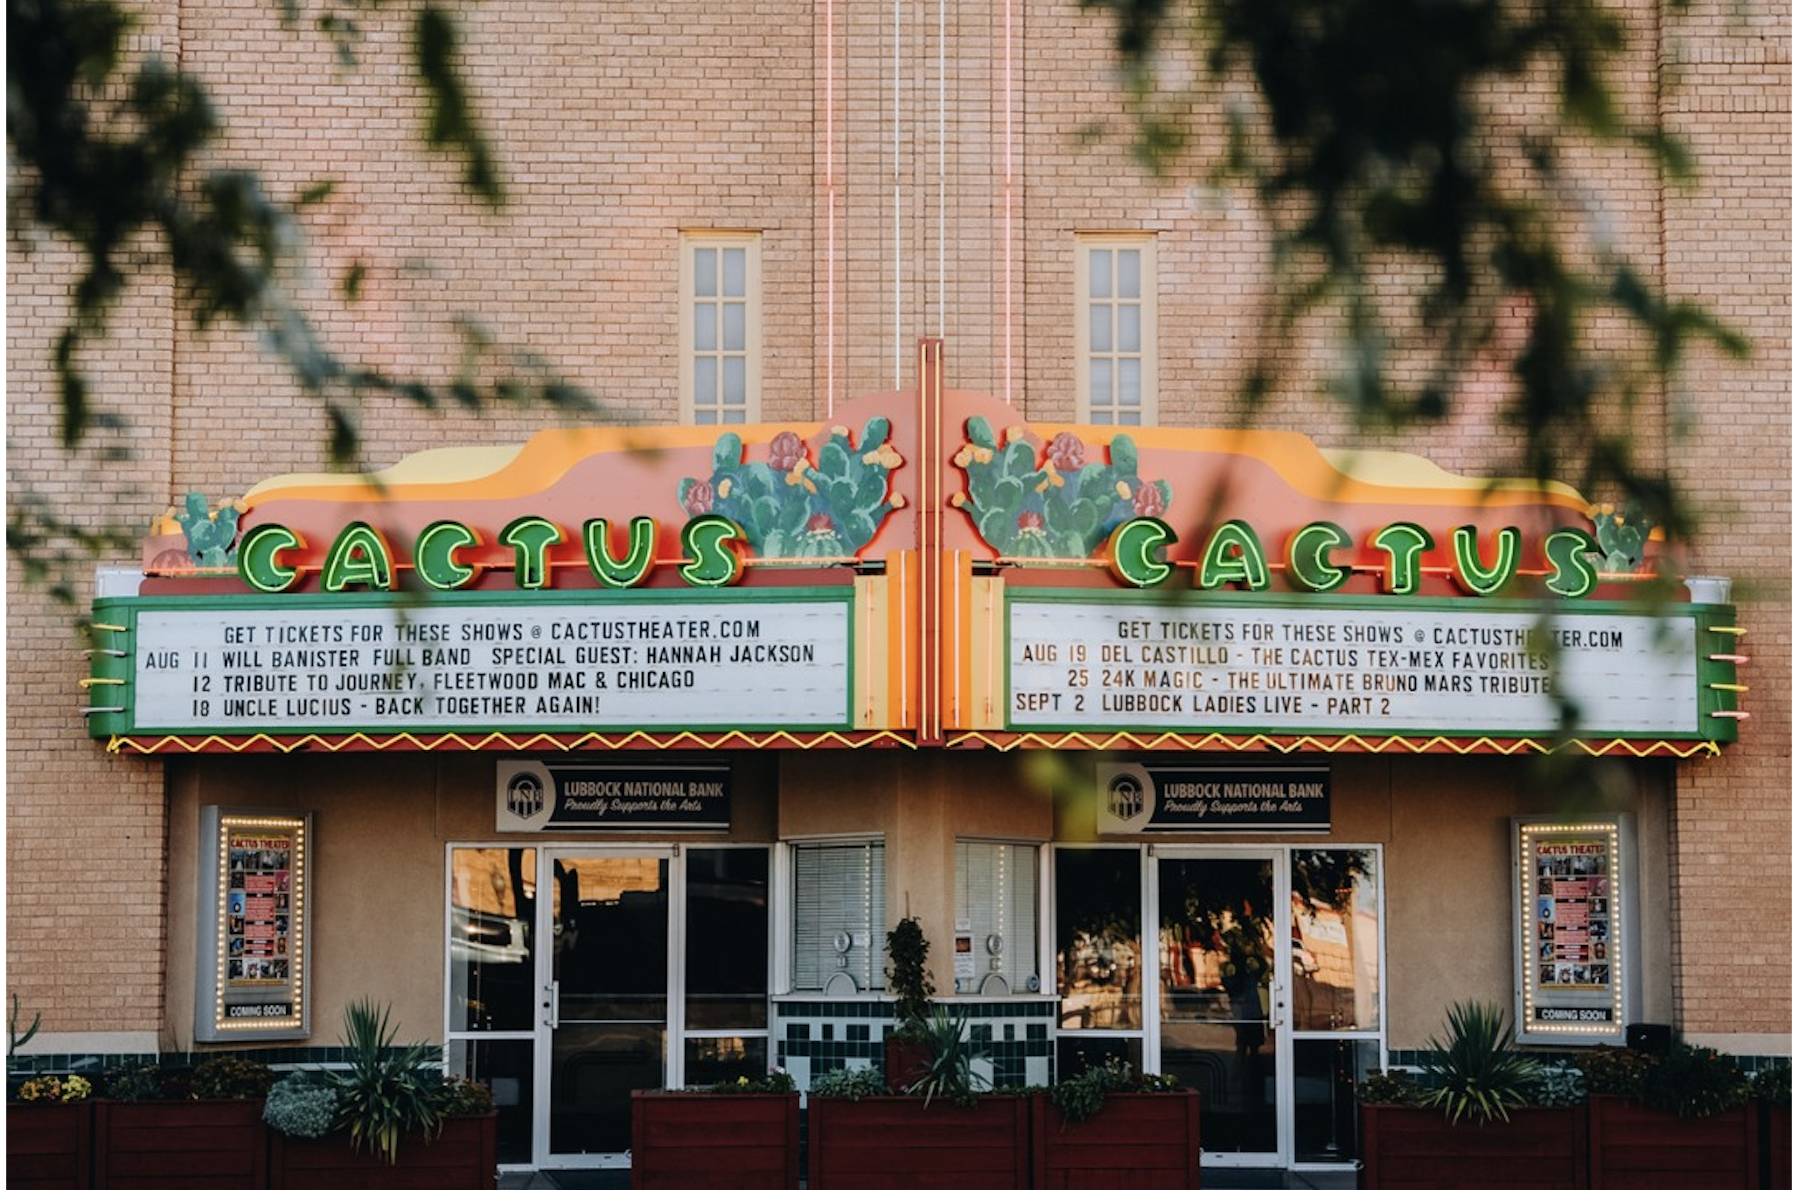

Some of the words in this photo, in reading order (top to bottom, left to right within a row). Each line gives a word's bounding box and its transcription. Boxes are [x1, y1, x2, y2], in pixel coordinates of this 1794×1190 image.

[237, 515, 747, 593] CACTUS
[1105, 516, 1598, 597] CACTUS
[225, 627, 256, 643] GET
[266, 626, 342, 643] TICKETS
[351, 625, 382, 642] FOR
[395, 624, 450, 641] THESE
[462, 623, 522, 640] SHOWS
[551, 621, 759, 639] CACTUSTHEATER.COM
[1118, 621, 1150, 639] GET
[1161, 622, 1234, 640] TICKETS
[1243, 623, 1273, 641] FOR
[1282, 624, 1336, 642] THESE
[1343, 626, 1403, 643] SHOWS
[1434, 628, 1622, 648] CACTUSTHTER.COM
[146, 652, 179, 669] AUG
[193, 652, 208, 668] 11
[222, 651, 262, 668] WILL
[272, 650, 359, 667] BANISTER
[373, 649, 415, 666] FULL
[423, 648, 470, 666] BAND
[492, 647, 565, 665] SPECIAL
[576, 646, 638, 664] GUEST:
[647, 645, 721, 663] HANNAH
[730, 645, 814, 662] JACKSON
[1023, 645, 1057, 661] AUG
[1070, 645, 1086, 661] 19
[1102, 646, 1132, 663] DEL
[1141, 646, 1228, 664] CASTILLO
[1251, 648, 1282, 665] THE
[1291, 649, 1357, 667] CACTUS
[1369, 651, 1444, 668] TEX-MEX
[1453, 652, 1549, 670] FAVORITES
[193, 675, 211, 692] 12
[224, 675, 297, 692] TRIBUTE
[307, 674, 328, 691] TO
[336, 673, 425, 690] JOURNEY,
[434, 672, 538, 690] FLEETWOOD
[548, 672, 586, 689] MAC
[596, 672, 607, 688] &
[617, 670, 694, 688] CHICAGO
[1068, 670, 1088, 687] 25
[1102, 670, 1135, 687] 24K
[1144, 671, 1203, 688] MAGIC
[1227, 672, 1259, 689] THE
[1266, 672, 1354, 690] ULTIMATE
[1364, 674, 1417, 692] BRUNO
[1425, 675, 1472, 692] MARS
[1480, 676, 1550, 693] TRIBUTE
[193, 700, 209, 716] 18
[224, 700, 277, 716] UNCLE
[287, 699, 351, 715] LUCIUS
[376, 698, 423, 715] BACK
[436, 697, 526, 714] TOGETHER
[537, 696, 600, 713] AGAIN!
[1016, 693, 1062, 711] SEPT
[1075, 694, 1085, 711] 2
[1102, 694, 1183, 712] LUBBOCK
[1193, 695, 1256, 713] LADIES
[1264, 696, 1302, 713] LIVE
[1328, 697, 1372, 715] PART
[1381, 698, 1390, 715] 2
[564, 781, 621, 797] LUBBOCK
[624, 781, 687, 797] NATIONAL
[689, 782, 723, 797] BANK
[1164, 783, 1220, 798] LUBBOCK
[1224, 783, 1286, 798] NATIONAL
[1289, 783, 1324, 798] BANK
[564, 799, 608, 816] Proudly
[610, 799, 657, 814] Supports
[660, 799, 676, 811] the
[679, 800, 702, 811] Arts
[1164, 800, 1208, 818] Proudly
[1210, 800, 1257, 815] Supports
[1260, 800, 1276, 812] the
[1279, 801, 1302, 812] Arts
[230, 1005, 262, 1017] COMING
[263, 1005, 286, 1016] SOON
[1541, 1009, 1578, 1020] COMING
[1579, 1010, 1606, 1020] SOON
